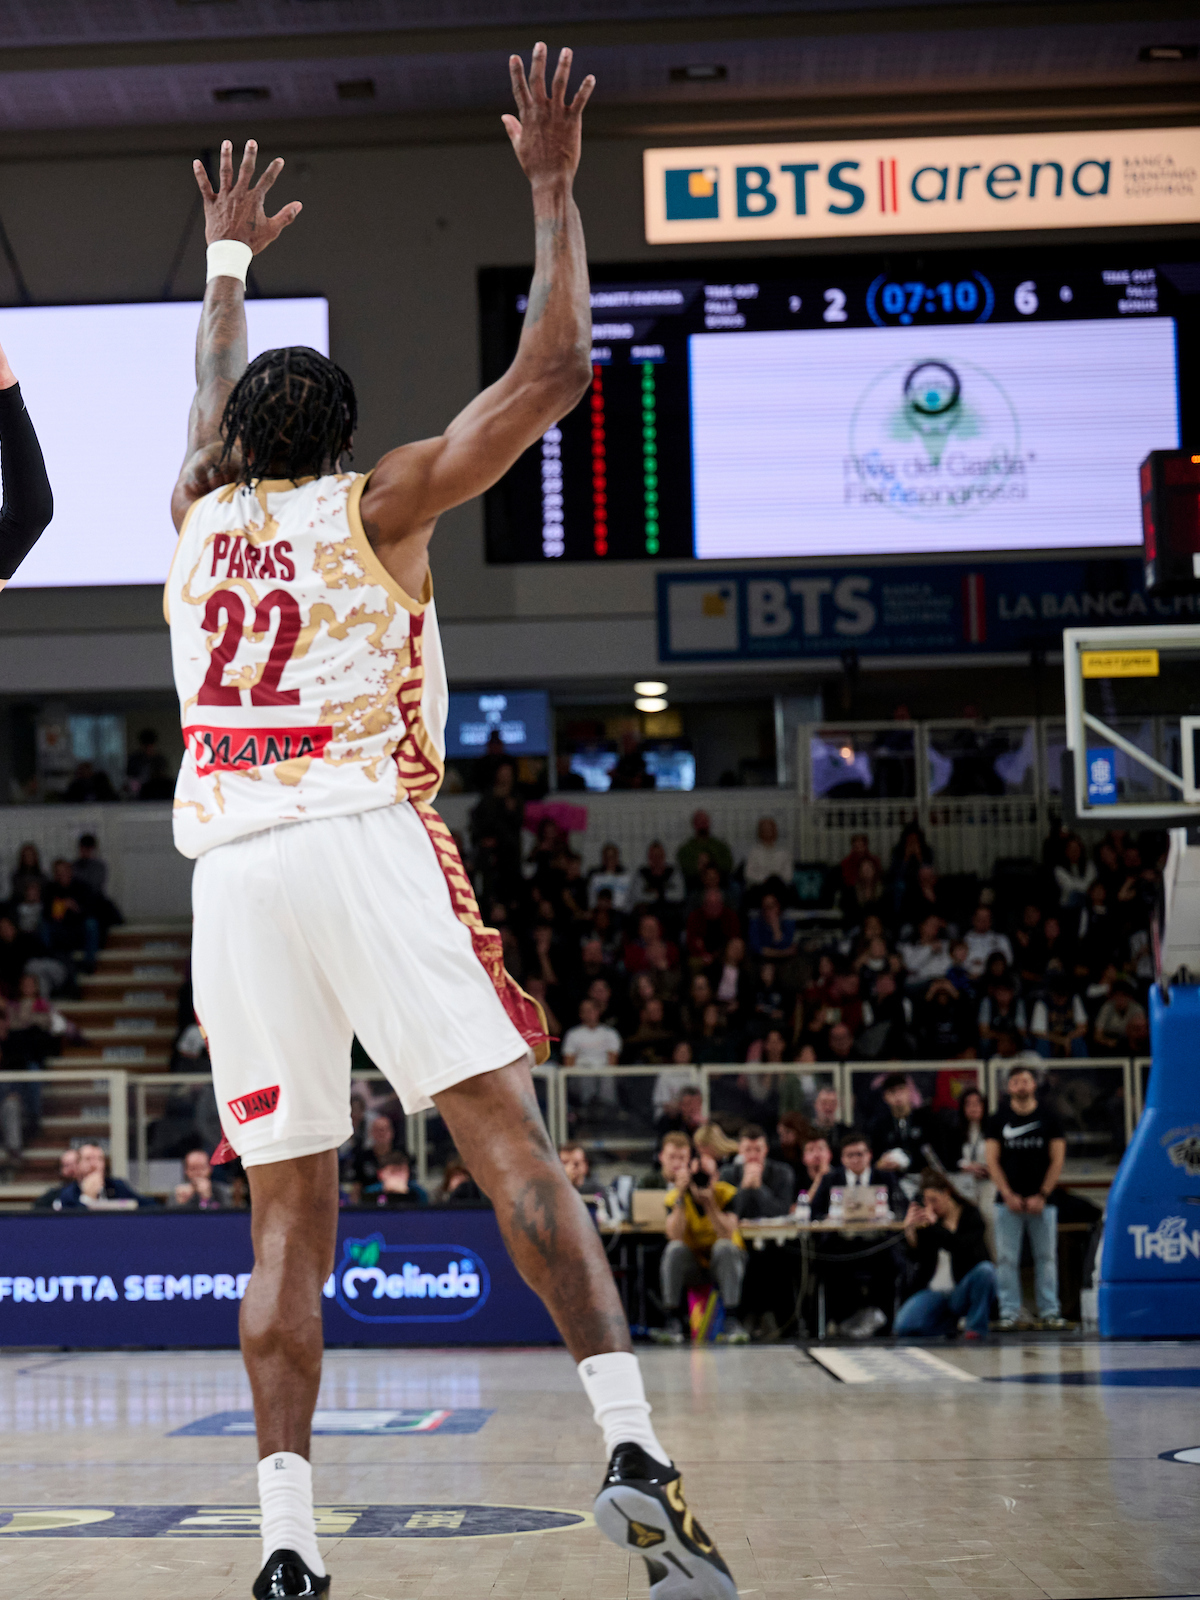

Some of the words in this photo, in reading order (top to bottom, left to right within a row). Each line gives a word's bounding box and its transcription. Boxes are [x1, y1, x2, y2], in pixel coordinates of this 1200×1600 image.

[735, 161, 866, 219] BTS
[910, 157, 1113, 203] arena
[823, 287, 848, 323] 2
[882, 279, 978, 315] 07:10
[1014, 280, 1039, 315] 6
[746, 577, 877, 638] BTS
[998, 594, 1036, 620] LA
[1041, 590, 1150, 618] BANCA
[197, 589, 301, 707] 22
[342, 1261, 480, 1299] Melinda
